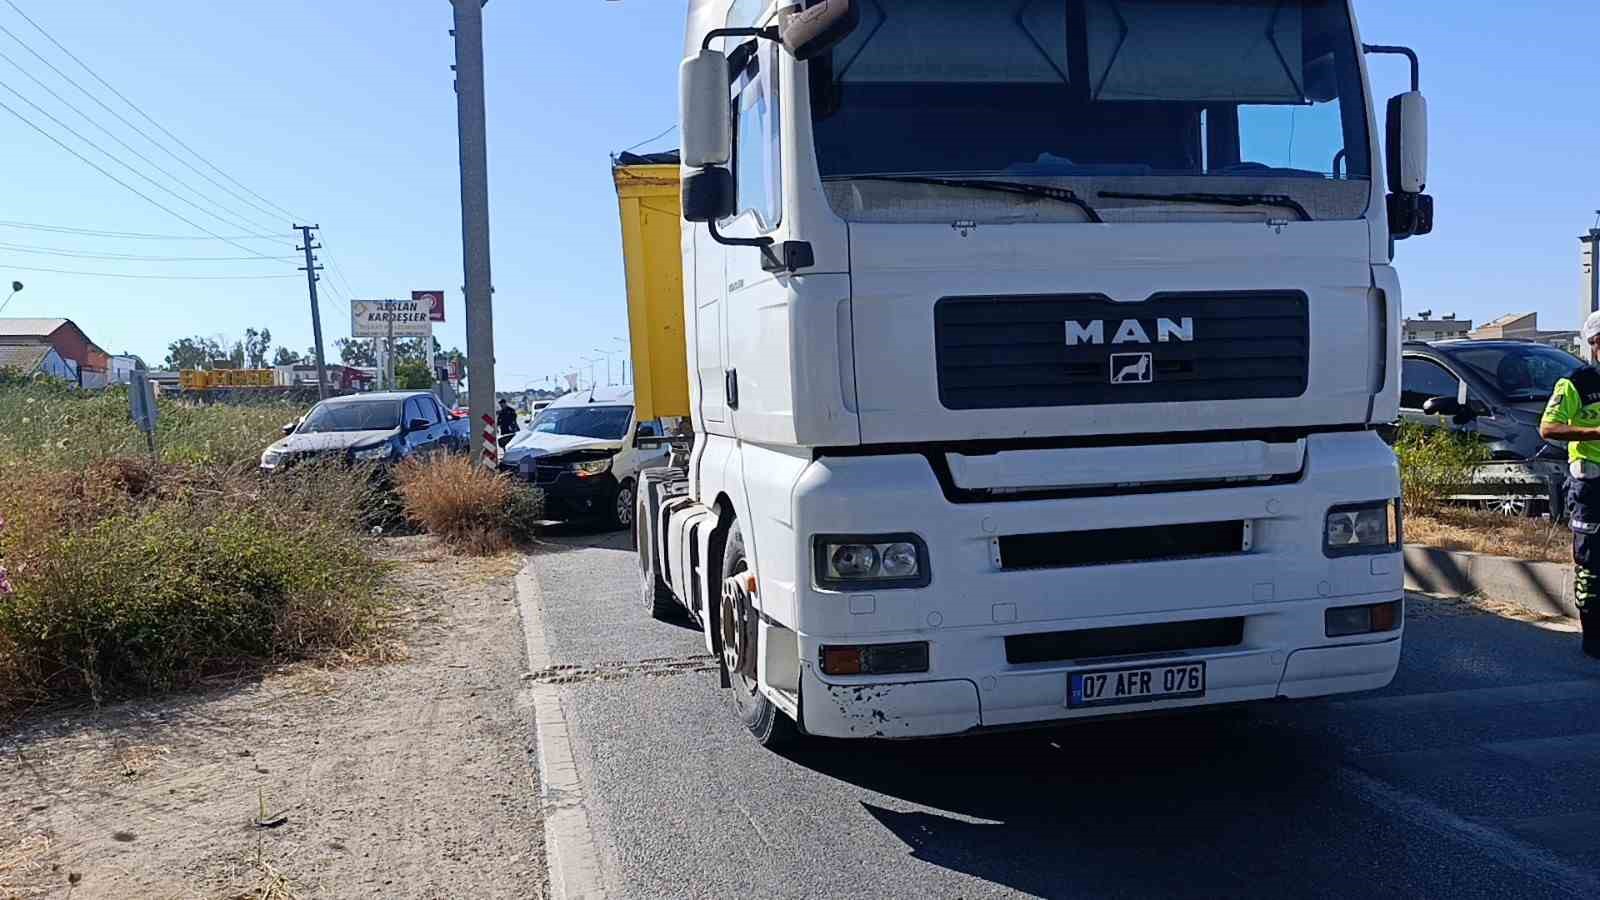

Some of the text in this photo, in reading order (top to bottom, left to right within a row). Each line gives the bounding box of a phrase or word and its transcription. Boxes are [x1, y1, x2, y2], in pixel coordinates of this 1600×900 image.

[368, 313, 427, 323] KARDEŞLER
[1065, 317, 1194, 345] MAN
[1084, 667, 1199, 699] 07 AFR 076
